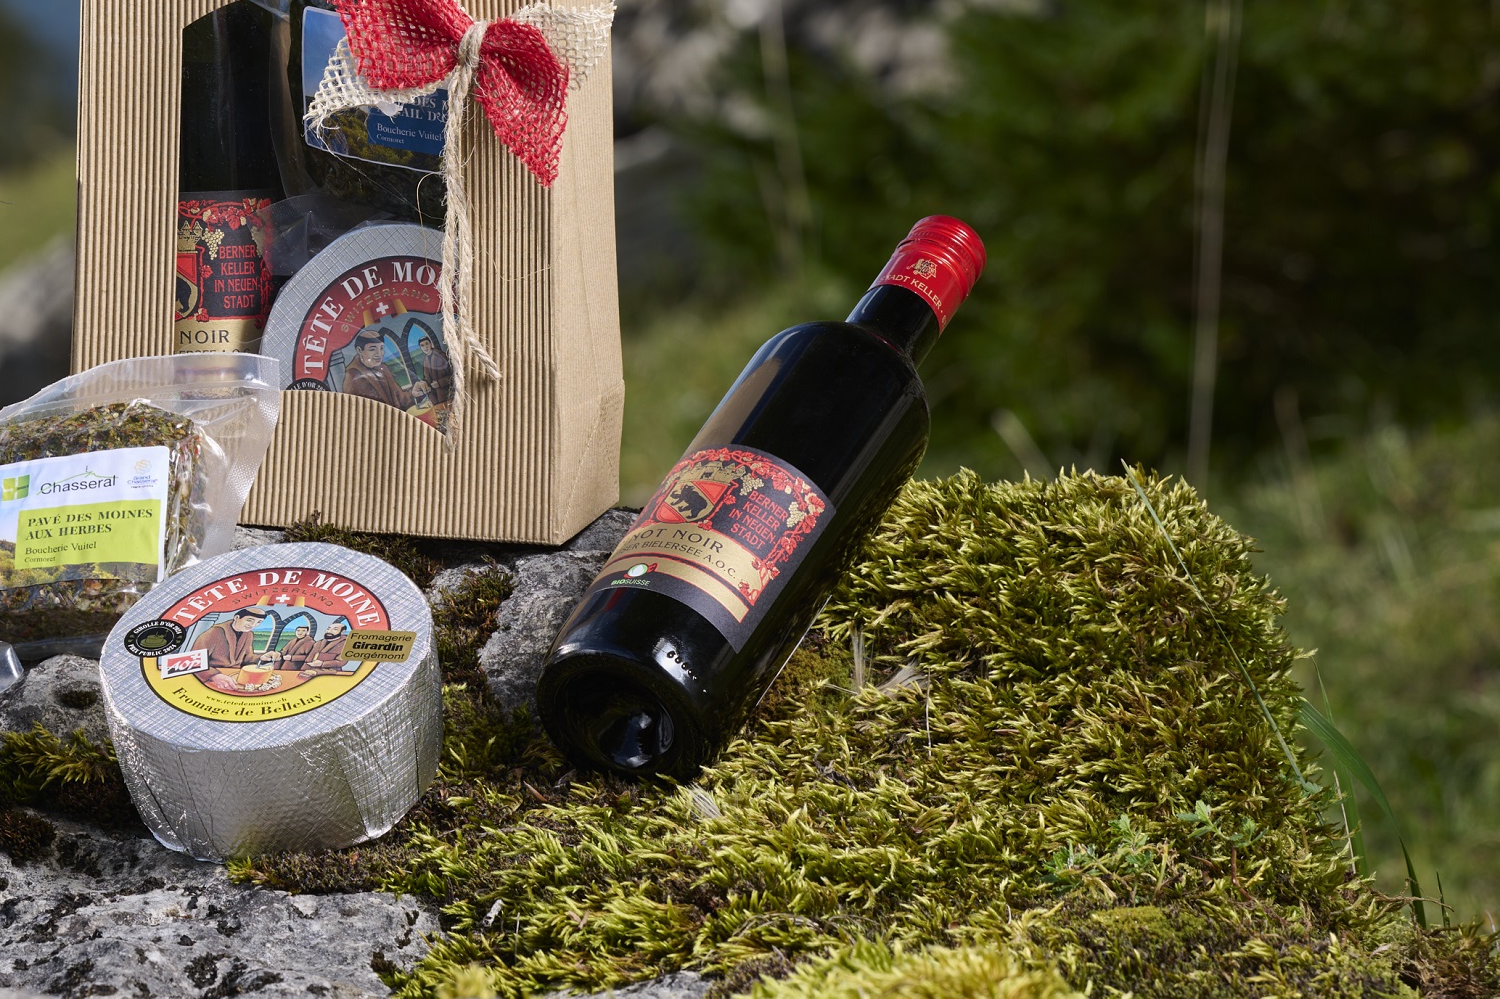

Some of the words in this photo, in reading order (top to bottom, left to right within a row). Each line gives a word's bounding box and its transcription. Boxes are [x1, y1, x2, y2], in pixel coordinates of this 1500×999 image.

[377, 123, 416, 137] Boucherie
[419, 130, 441, 141] Vuitel
[377, 134, 404, 144] Cormoret
[220, 245, 256, 259] BERNER
[221, 262, 255, 275] KELLER
[214, 280, 224, 292] IN
[224, 295, 254, 308] STADT
[910, 279, 942, 310] KELLER
[341, 288, 431, 332] SWITZERLAND
[303, 296, 344, 374] TÊTE
[341, 266, 383, 300] DE
[180, 330, 229, 344] NOIR
[40, 475, 115, 494] Chasseral
[729, 508, 743, 520] IN
[749, 490, 788, 522] BERNER
[28, 514, 61, 527] PAVÉ
[66, 513, 92, 522] DES
[98, 509, 153, 520] MOINES
[743, 502, 780, 531] KELLER
[25, 529, 53, 540] AUX
[59, 524, 112, 536] HERBES
[731, 523, 765, 549] STADT
[25, 544, 68, 555] Boucherie
[71, 542, 96, 551] Vuitel
[673, 530, 724, 553] NOIR
[642, 540, 701, 558] BIELERSEE
[703, 554, 736, 579] A.O.C.
[173, 578, 248, 622] TÊTE
[258, 571, 302, 586] DE
[309, 572, 381, 627] MOINE
[232, 587, 333, 607] SWITZERLAND
[133, 621, 159, 634] GIROLLE
[351, 633, 412, 642] Fromagerie
[353, 642, 404, 651] Girardin
[345, 651, 404, 660] Corgémont
[168, 659, 201, 671] AOP
[172, 687, 230, 716] Fromage
[235, 708, 254, 716] de
[261, 693, 323, 715] Bellelay
[206, 695, 288, 706] www.tetedemoine.ch
